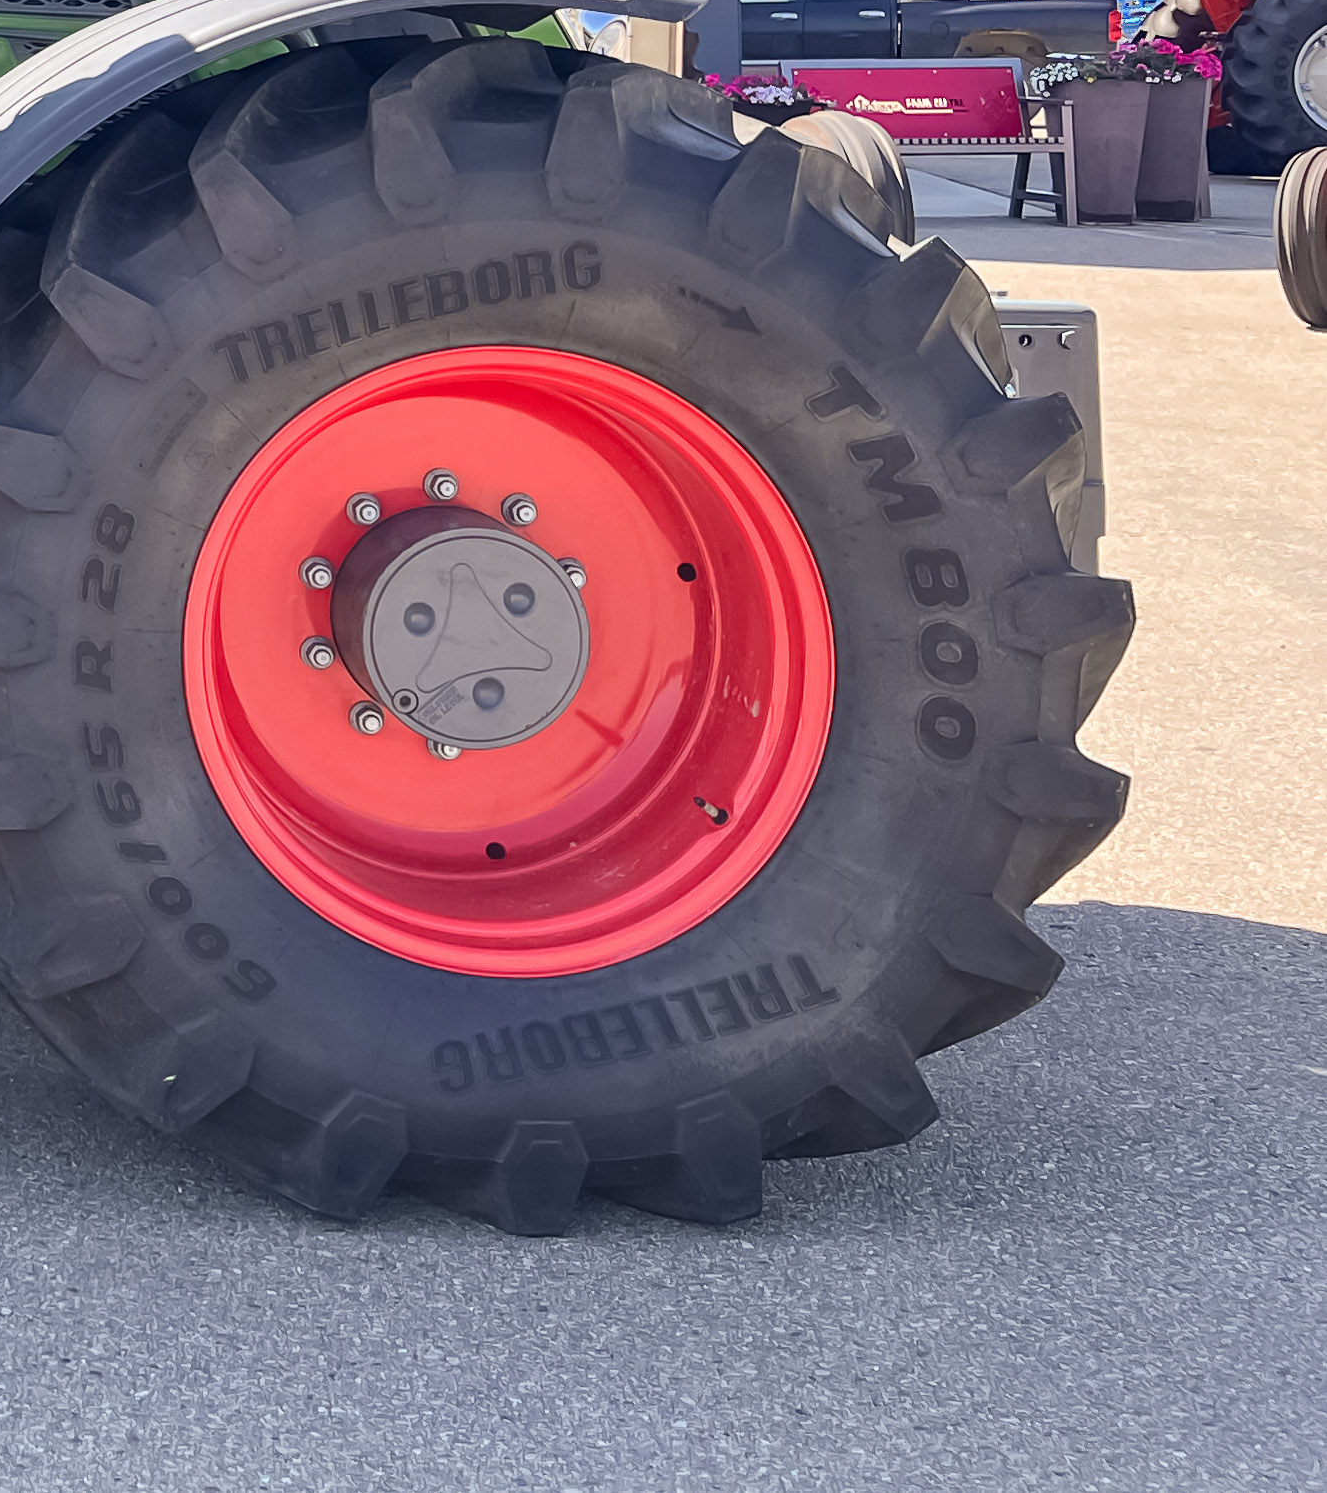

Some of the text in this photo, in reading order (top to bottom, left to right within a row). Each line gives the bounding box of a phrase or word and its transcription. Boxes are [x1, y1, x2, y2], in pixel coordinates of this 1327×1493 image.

[213, 240, 603, 385] TRELLEBORG
[80, 502, 137, 613] 28
[804, 364, 981, 763] TM800
[74, 637, 113, 693] R
[430, 953, 842, 1095] TRELLEBORG
